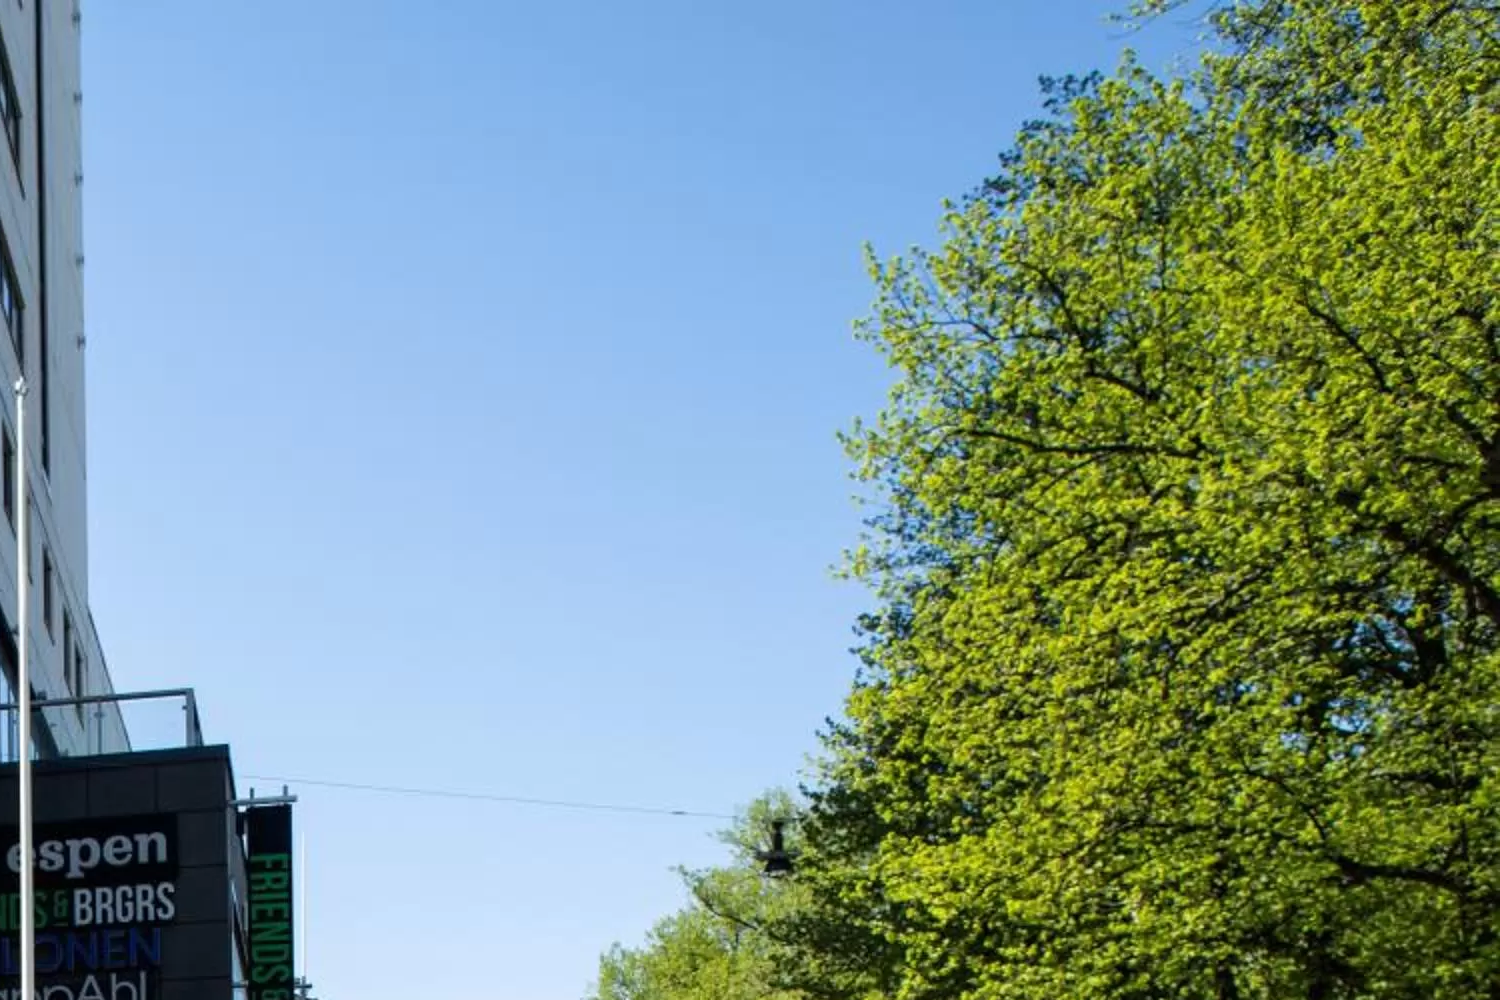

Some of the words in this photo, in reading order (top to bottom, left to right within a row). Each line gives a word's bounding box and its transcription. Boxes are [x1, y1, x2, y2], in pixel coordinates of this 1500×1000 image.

[6, 831, 168, 878] espen
[53, 889, 69, 927] &
[73, 882, 176, 926] BRGRS
[249, 853, 290, 983] FRIENDS
